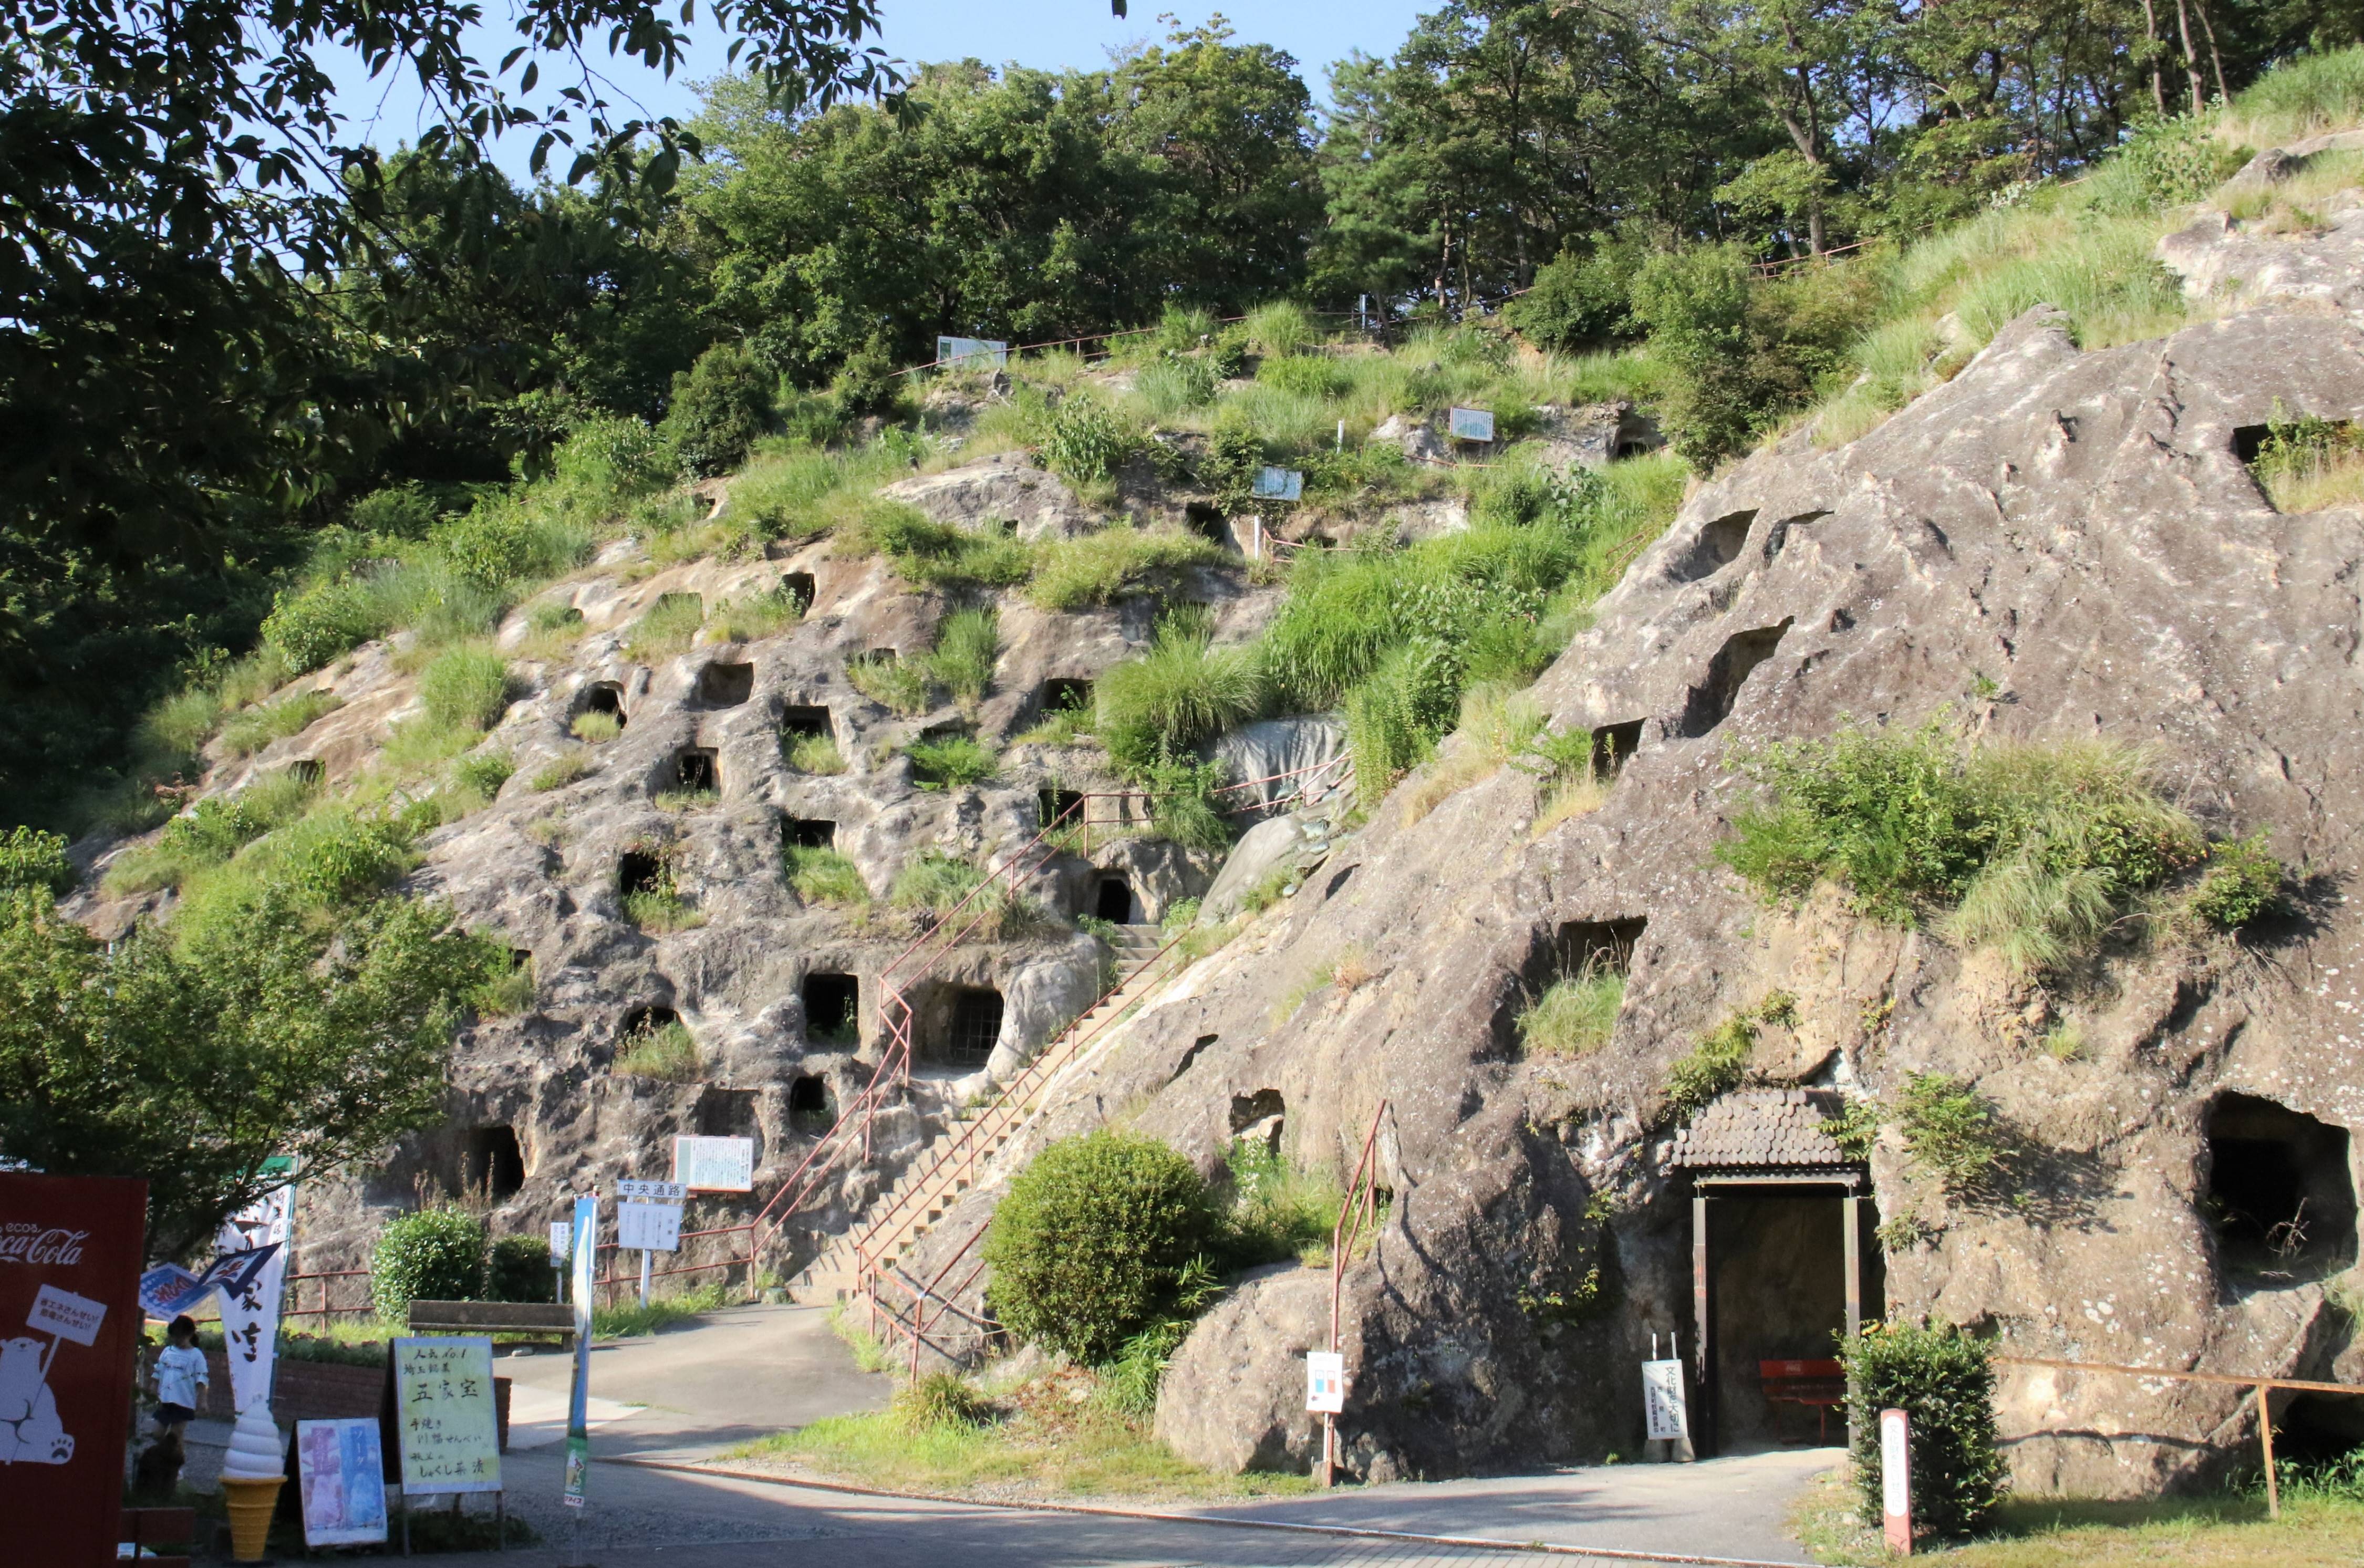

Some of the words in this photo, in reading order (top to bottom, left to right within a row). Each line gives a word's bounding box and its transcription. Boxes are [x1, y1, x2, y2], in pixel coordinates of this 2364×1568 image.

[623, 1183, 680, 1197] 中央通路
[0, 1228, 91, 1265] ca-Cola
[411, 1378, 479, 1402] 五家宝
[1665, 1366, 1679, 1432] 文化財を大切に
